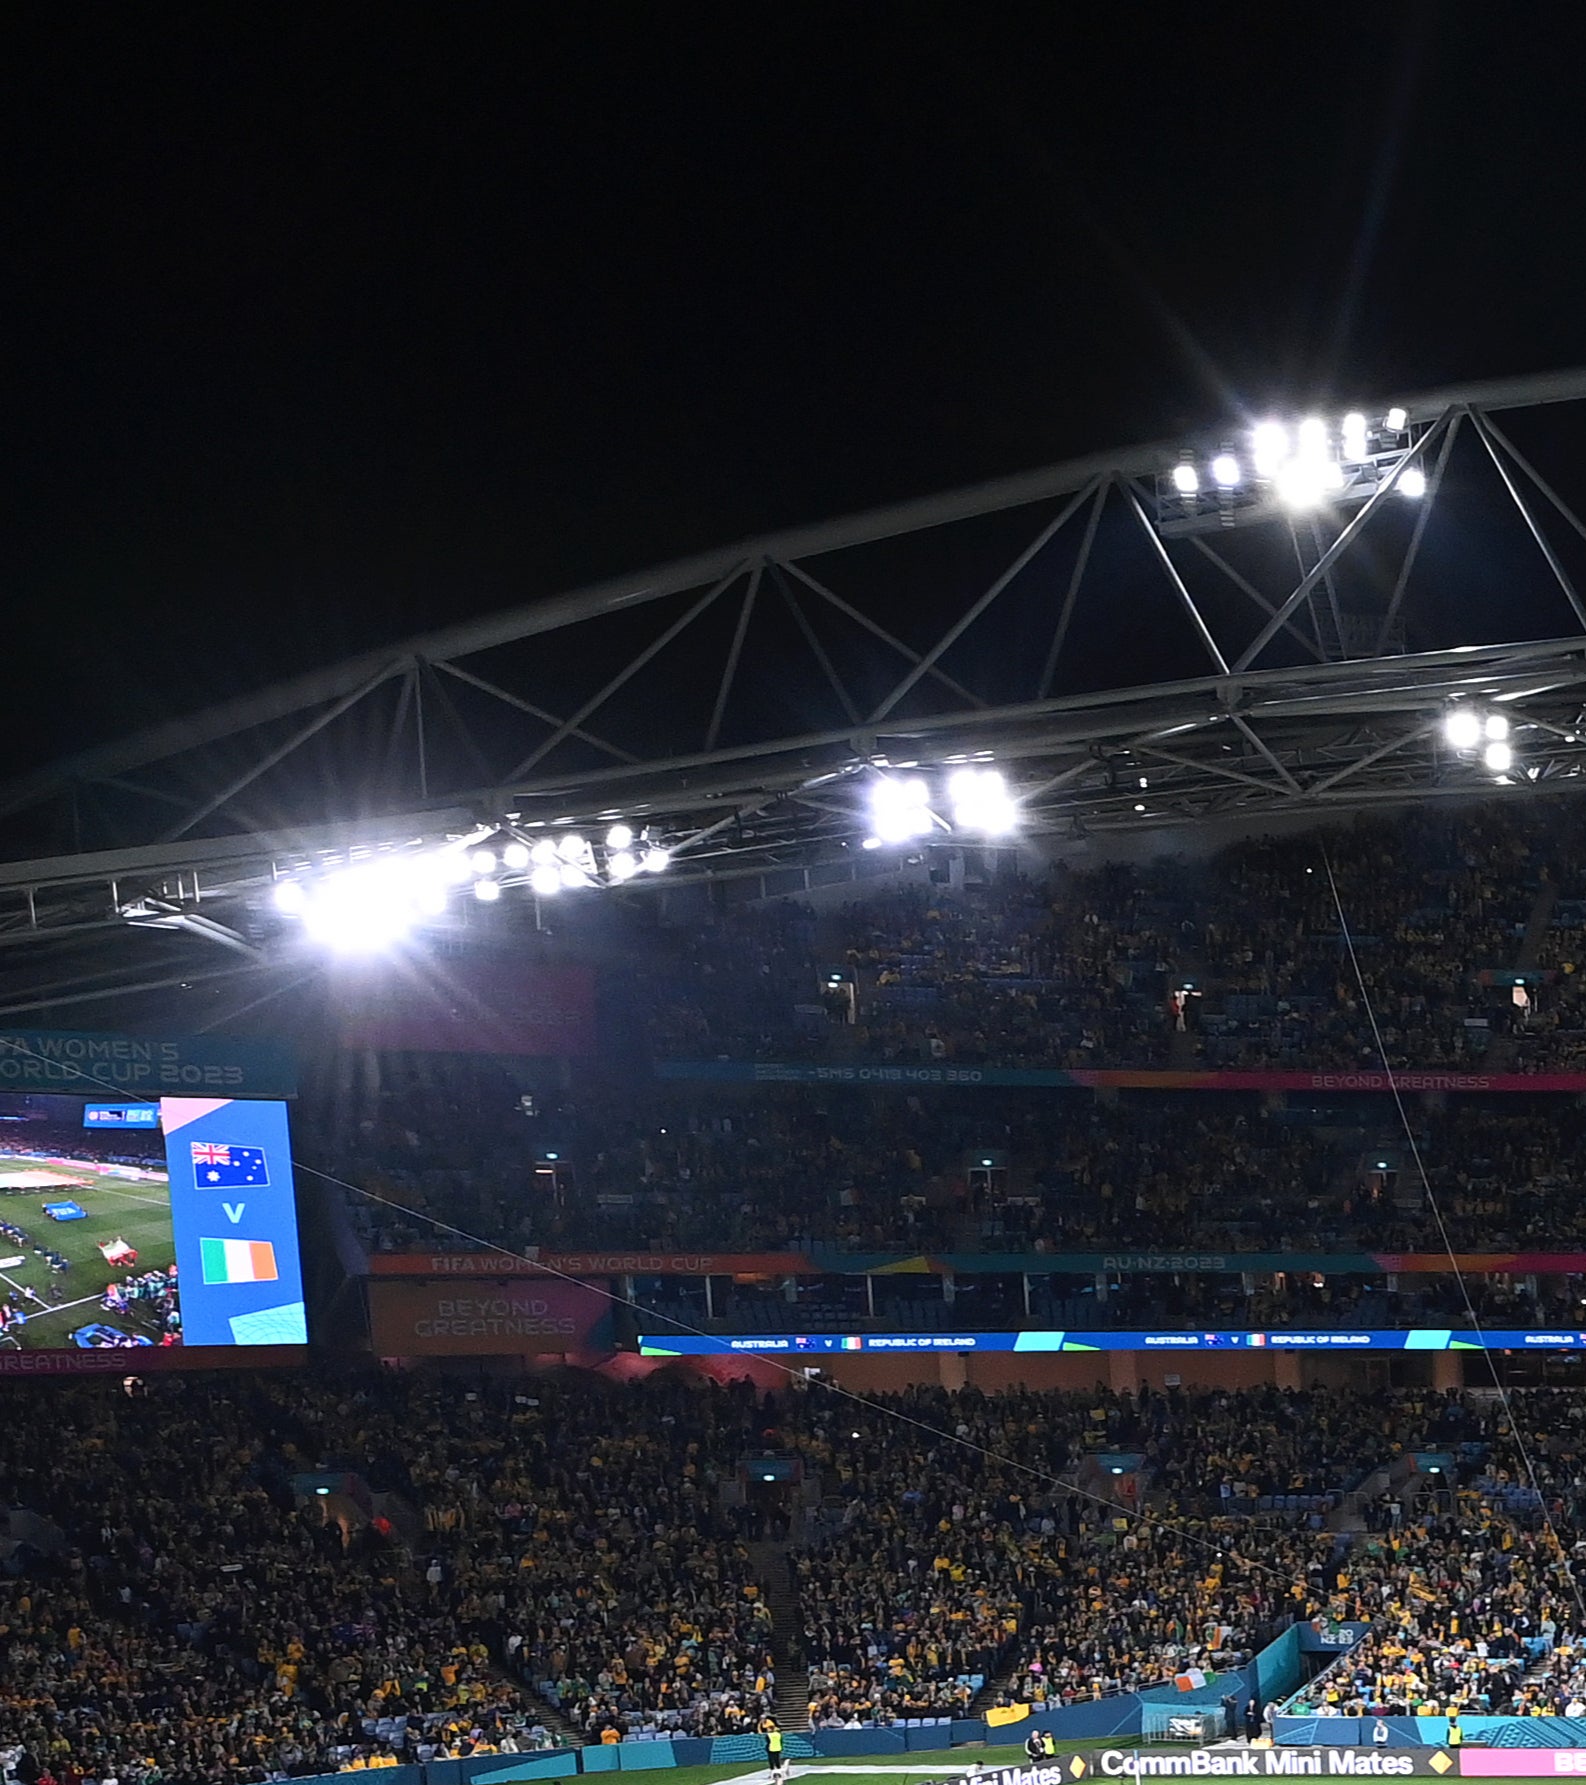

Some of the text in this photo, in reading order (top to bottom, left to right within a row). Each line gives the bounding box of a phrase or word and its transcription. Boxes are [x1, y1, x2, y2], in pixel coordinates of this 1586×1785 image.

[38, 1039, 179, 1062] WOMEN'S
[92, 1062, 151, 1082] CUP
[160, 1065, 244, 1085] 2023
[1312, 1075, 1382, 1089] BEYOND
[222, 1203, 246, 1224] V
[432, 1258, 475, 1272] FIFA
[588, 1257, 664, 1271] WORLD
[671, 1257, 712, 1270] CUP
[438, 1300, 548, 1317] BEYOND
[415, 1317, 576, 1338] GREATNESS
[730, 1337, 976, 1349] AUSTRALIA REPUBLIC OF IRELAND
[1144, 1335, 1371, 1345] AUSTRALIA REPUBLIC OF IRELAND
[1524, 1335, 1575, 1344] AUSTRALIA
[1100, 1750, 1413, 1778] CommBank Mini Mates
